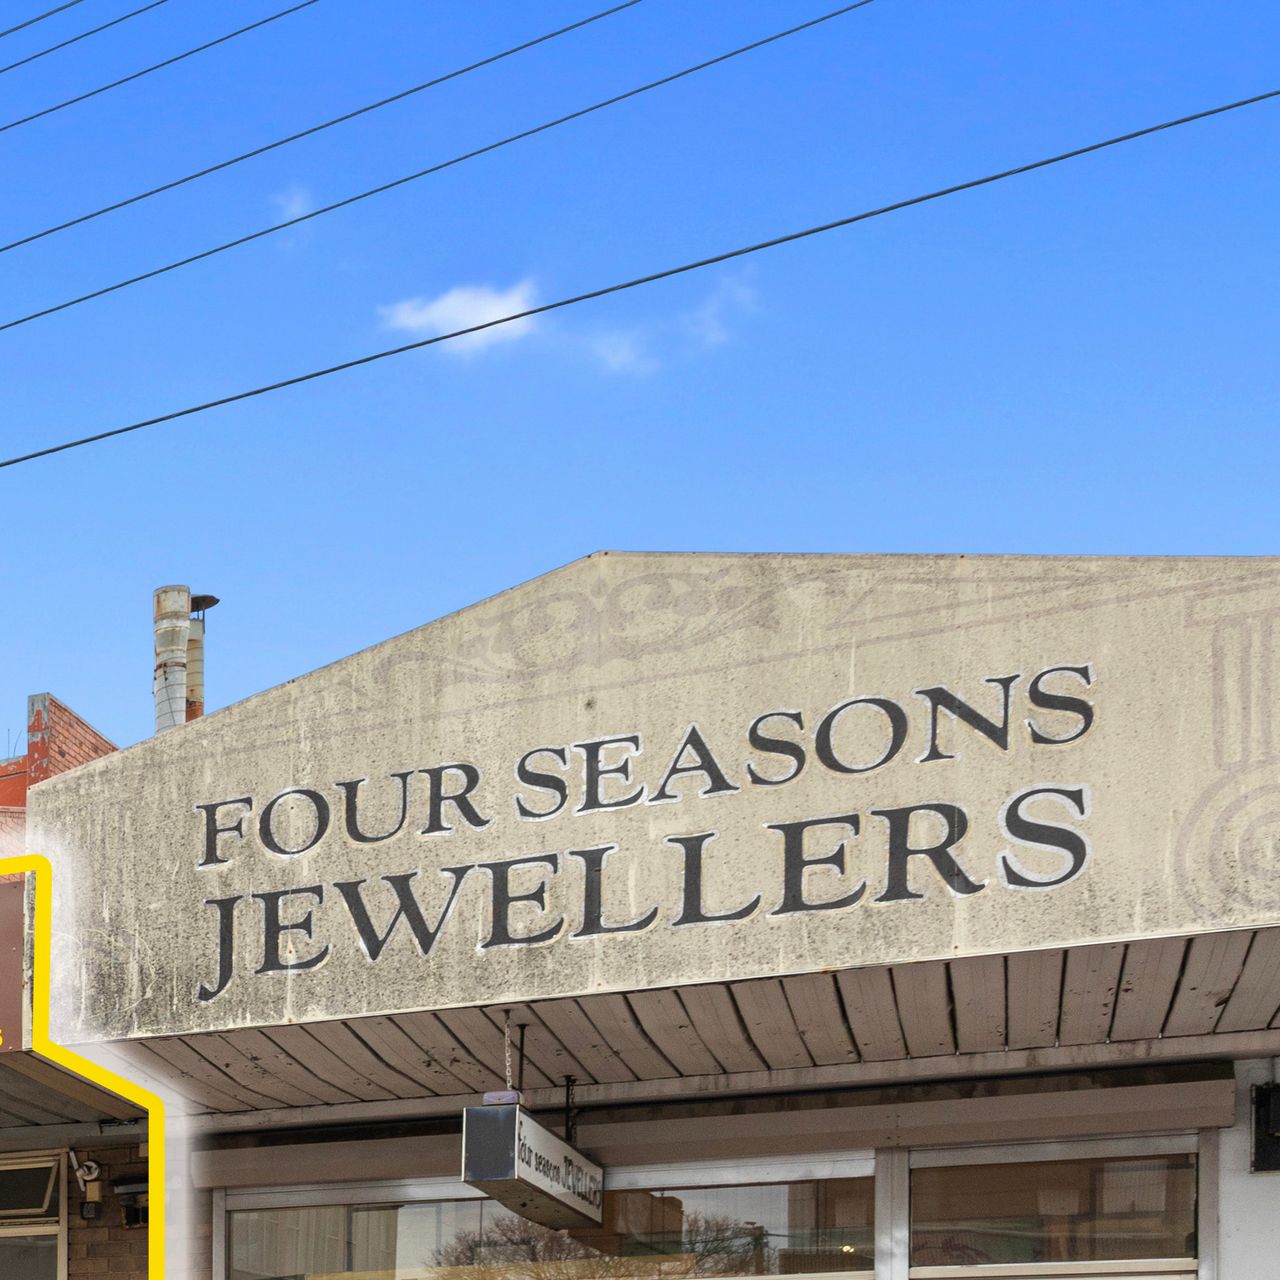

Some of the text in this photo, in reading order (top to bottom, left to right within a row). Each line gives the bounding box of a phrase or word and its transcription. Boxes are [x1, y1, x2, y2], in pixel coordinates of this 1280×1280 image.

[195, 664, 1095, 869] FOUR SEASONS
[197, 786, 1089, 1001] JEWELLERS
